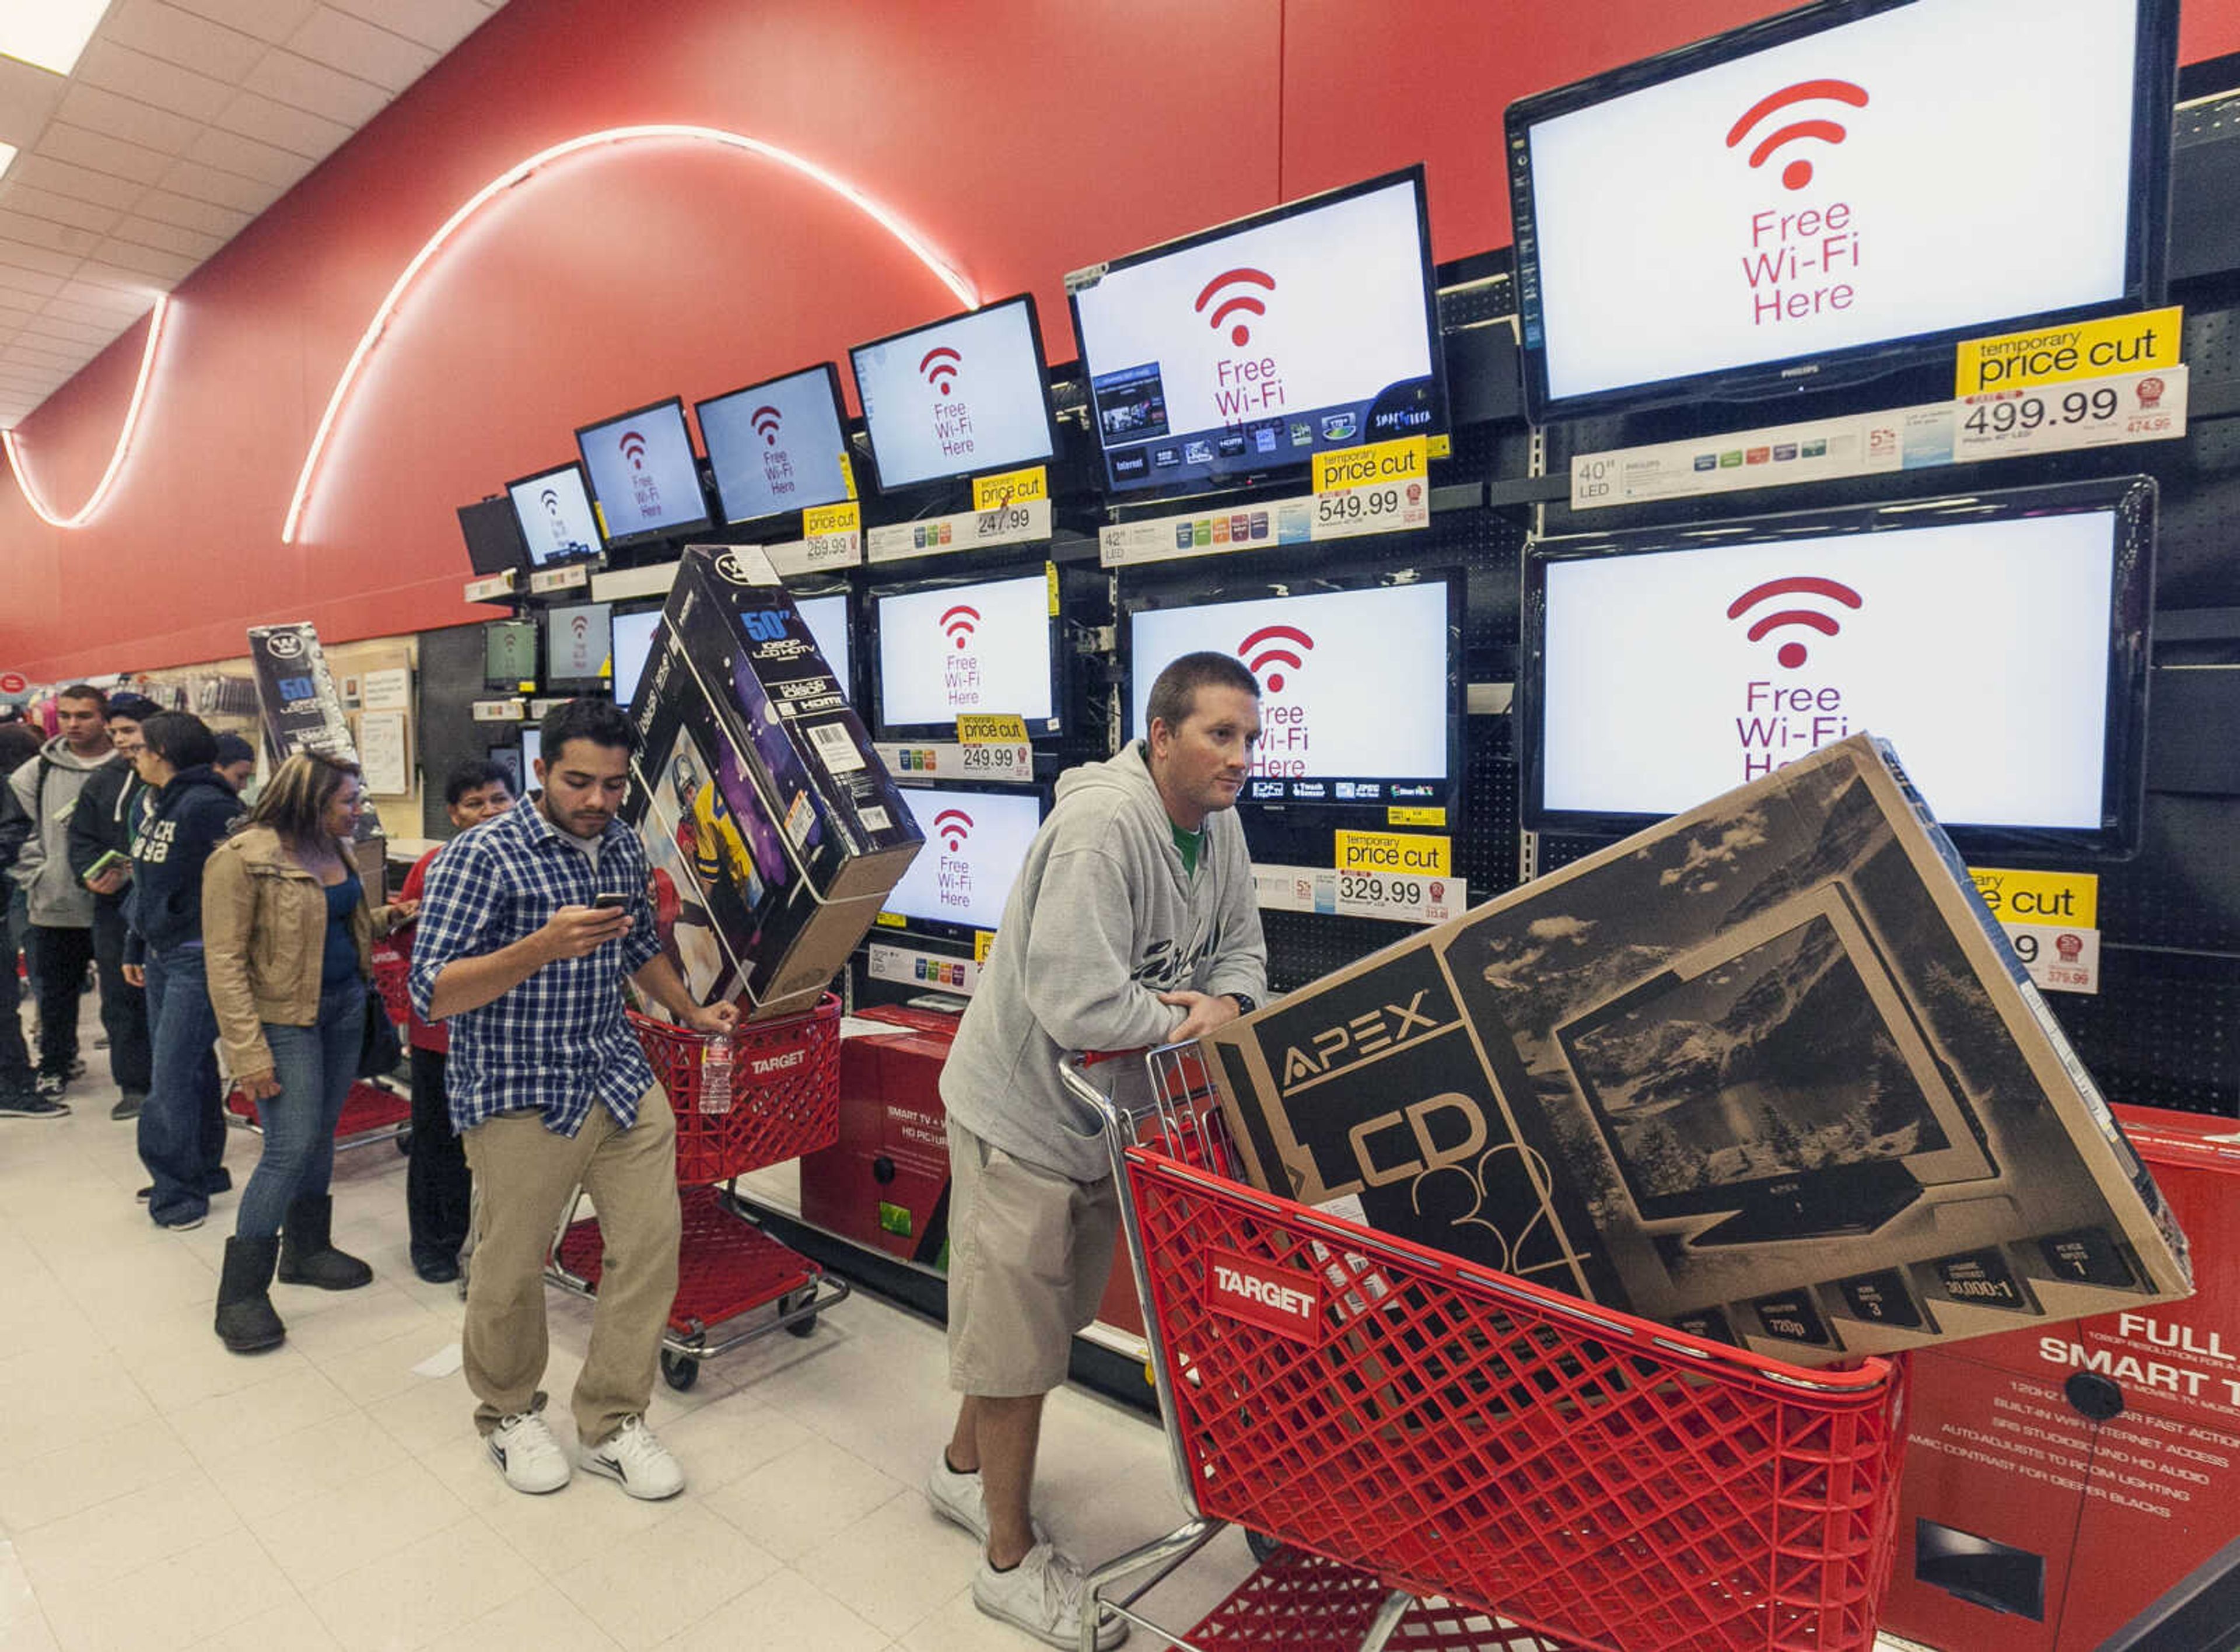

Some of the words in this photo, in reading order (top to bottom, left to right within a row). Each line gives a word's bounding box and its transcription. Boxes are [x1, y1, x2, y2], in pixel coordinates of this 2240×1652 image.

[1752, 203, 1849, 247] Free
[1742, 232, 1859, 288] Wi-Fi
[1755, 284, 1854, 325] Here
[1980, 330, 2082, 357] temporary
[1979, 348, 2077, 390] price
[2088, 329, 2157, 367] cut
[1219, 358, 1275, 387] Free
[1215, 379, 1284, 416] Wi-Fi
[935, 403, 966, 419] Free
[1964, 388, 2118, 434] 499.99
[935, 415, 972, 438] Wi-Fi
[764, 451, 786, 464] Free
[943, 438, 974, 457] Here
[1324, 449, 1376, 465] temporary
[765, 463, 793, 481] Wi-Fi
[1325, 461, 1376, 489] price
[1381, 450, 1415, 474] cut
[1579, 460, 1615, 481] 40"
[982, 485, 1015, 506] price
[1018, 479, 1039, 495] cut
[1580, 483, 1609, 498] LED
[1320, 490, 1398, 522] 549.99
[809, 514, 835, 531] price
[838, 513, 854, 526] cut
[978, 509, 1029, 533] 247.99
[807, 539, 846, 558] 269.99
[740, 610, 790, 642] 50"
[947, 655, 977, 672] Free
[945, 671, 979, 688] Wi-Fi
[949, 690, 979, 705] Here
[1748, 682, 1840, 712] Free
[1259, 702, 1303, 724] ree
[965, 723, 997, 740] price
[1001, 723, 1020, 737] cut
[1736, 717, 1847, 748] Wi-Fi
[964, 749, 1013, 766] 249.99
[1250, 755, 1305, 779] Here
[1347, 835, 1400, 848] temporary
[940, 856, 969, 873] Free
[1348, 846, 1399, 866] price
[1405, 848, 1439, 868] cut
[938, 874, 971, 891] Wi-Fi
[1340, 877, 1420, 904] 329.99
[940, 890, 970, 907] Here
[2012, 889, 2074, 916] cut
[1283, 989, 1437, 1087] APEX
[751, 1050, 806, 1074] TARGET
[920, 1114, 931, 1124] TV
[1298, 1092, 1488, 1203] LCD
[1412, 1144, 1591, 1275] 32
[2073, 1261, 2087, 1276] 1
[1213, 1266, 1316, 1318] TARGET
[1869, 1302, 1882, 1317] 3
[2120, 1312, 2236, 1361] FULL
[2129, 1340, 2197, 1363] RESOLUTION
[2039, 1337, 2210, 1395] SMART
[2221, 1378, 2240, 1405] T
[2146, 1417, 2185, 1433] FAST
[2090, 1424, 2162, 1450] INTERNET
[2166, 1444, 2230, 1468] ACCESS
[1908, 1433, 1941, 1450] AMIC
[1944, 1443, 2017, 1470] CONTRAST
[2020, 1465, 2048, 1480] FOR
[2050, 1475, 2107, 1499] DEEPER
[2110, 1492, 2171, 1518] BLACKS
[2048, 1453, 2067, 1465] TO
[2070, 1460, 2115, 1479] ROOM
[2118, 1474, 2190, 1502] LIGHTING
[2132, 1456, 2155, 1470] HD
[2159, 1465, 2210, 1485] AUDIO
